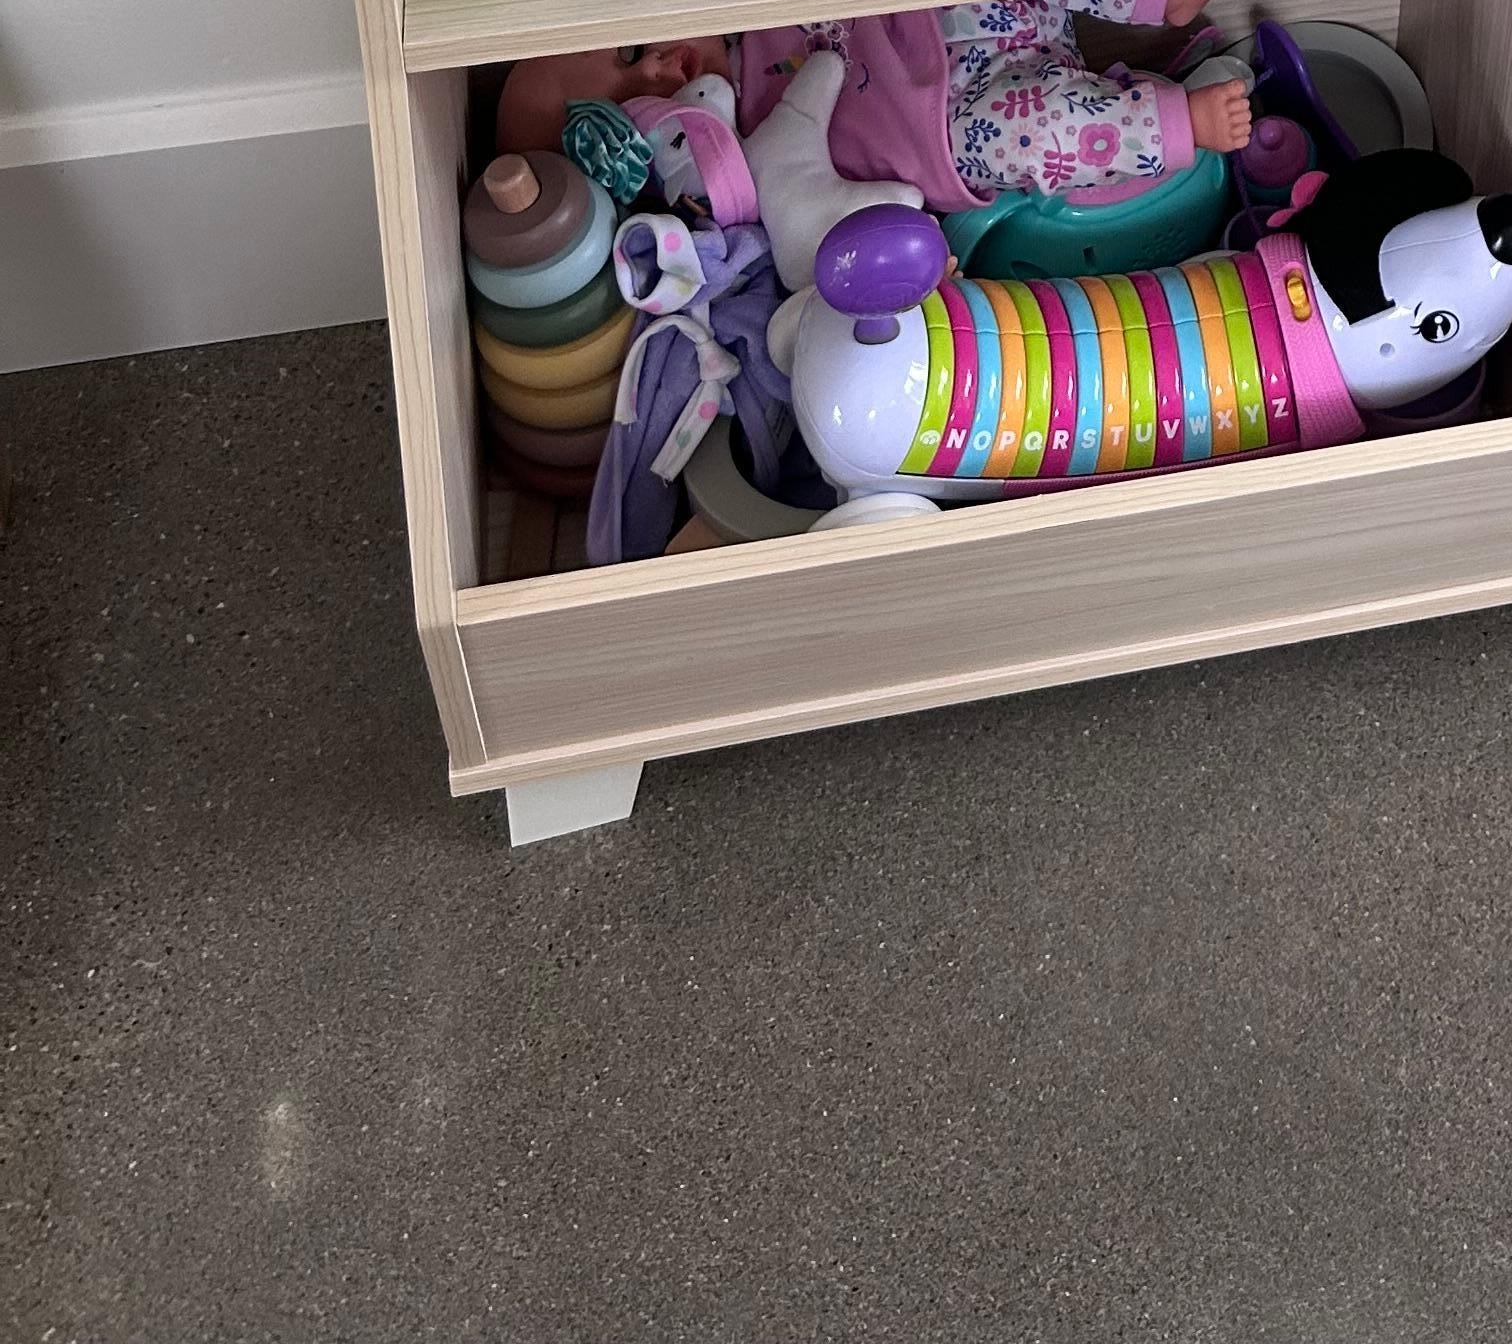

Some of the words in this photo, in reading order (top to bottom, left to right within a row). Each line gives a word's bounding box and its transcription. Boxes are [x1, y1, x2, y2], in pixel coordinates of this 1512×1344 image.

[947, 429, 966, 449] N
[973, 430, 992, 451] O
[1000, 431, 1016, 450] P
[1024, 431, 1043, 452] Q
[1053, 430, 1070, 449] R
[1082, 428, 1097, 448] S
[1111, 426, 1125, 444] T
[1135, 424, 1152, 442] U
[1163, 419, 1180, 438] V
[1188, 416, 1207, 435] W
[1217, 409, 1233, 429] X
[1244, 404, 1260, 423] Y
[1272, 399, 1289, 417] Z
